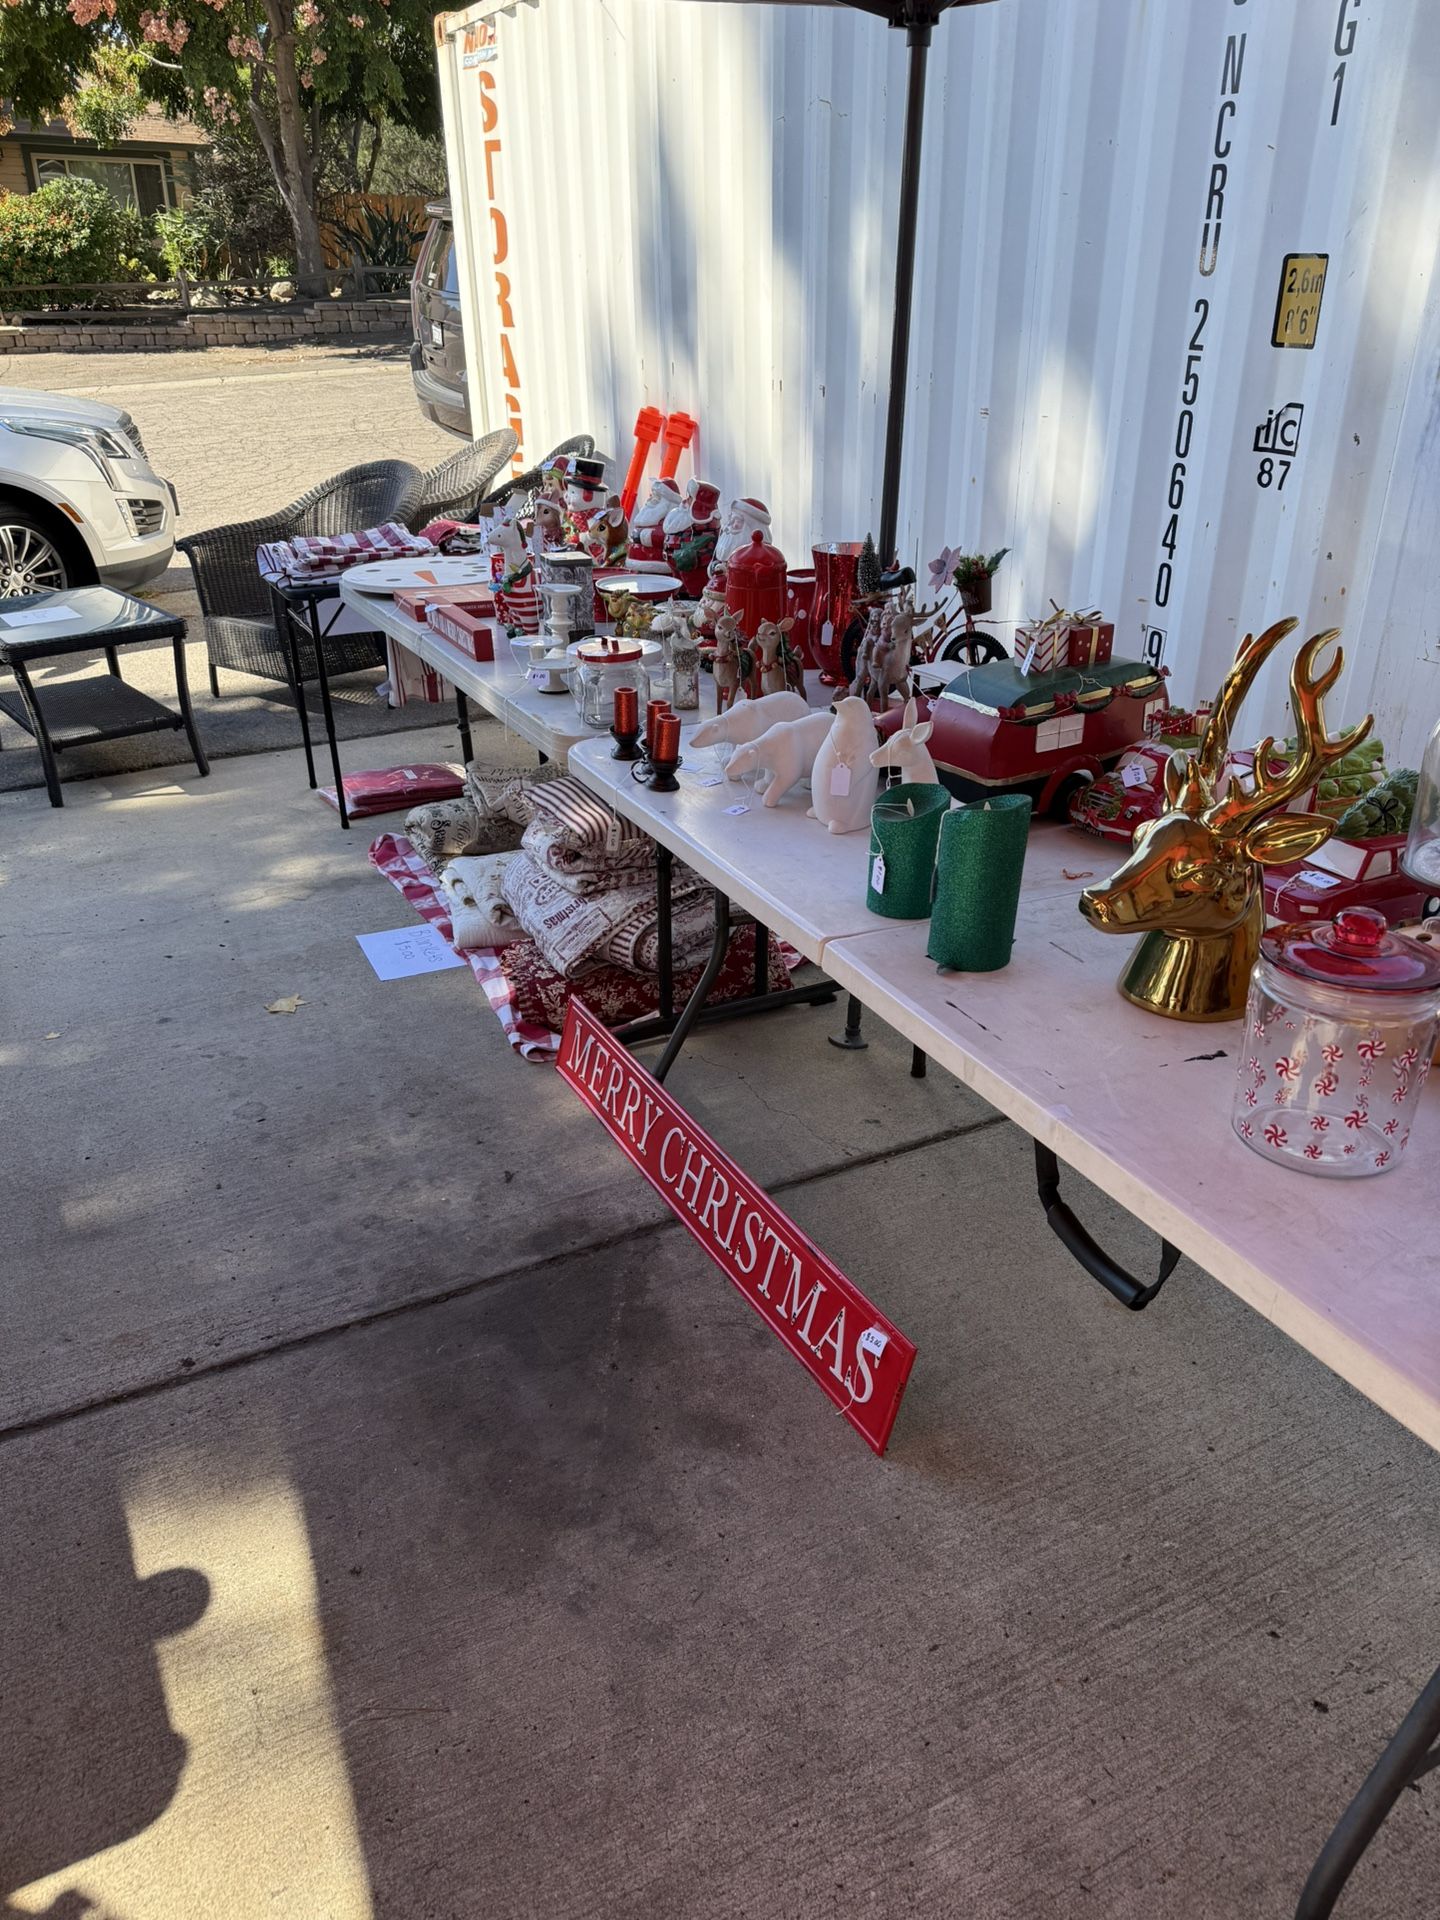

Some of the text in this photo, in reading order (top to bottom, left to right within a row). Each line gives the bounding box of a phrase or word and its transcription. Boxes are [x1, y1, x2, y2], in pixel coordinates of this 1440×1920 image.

[1155, 298, 1209, 607] 250640
[1257, 457, 1292, 491] 87
[1148, 630, 1163, 668] 9
[542, 894, 589, 930] hristmas
[565, 1020, 882, 1405] MERRY CHRISTMAS
